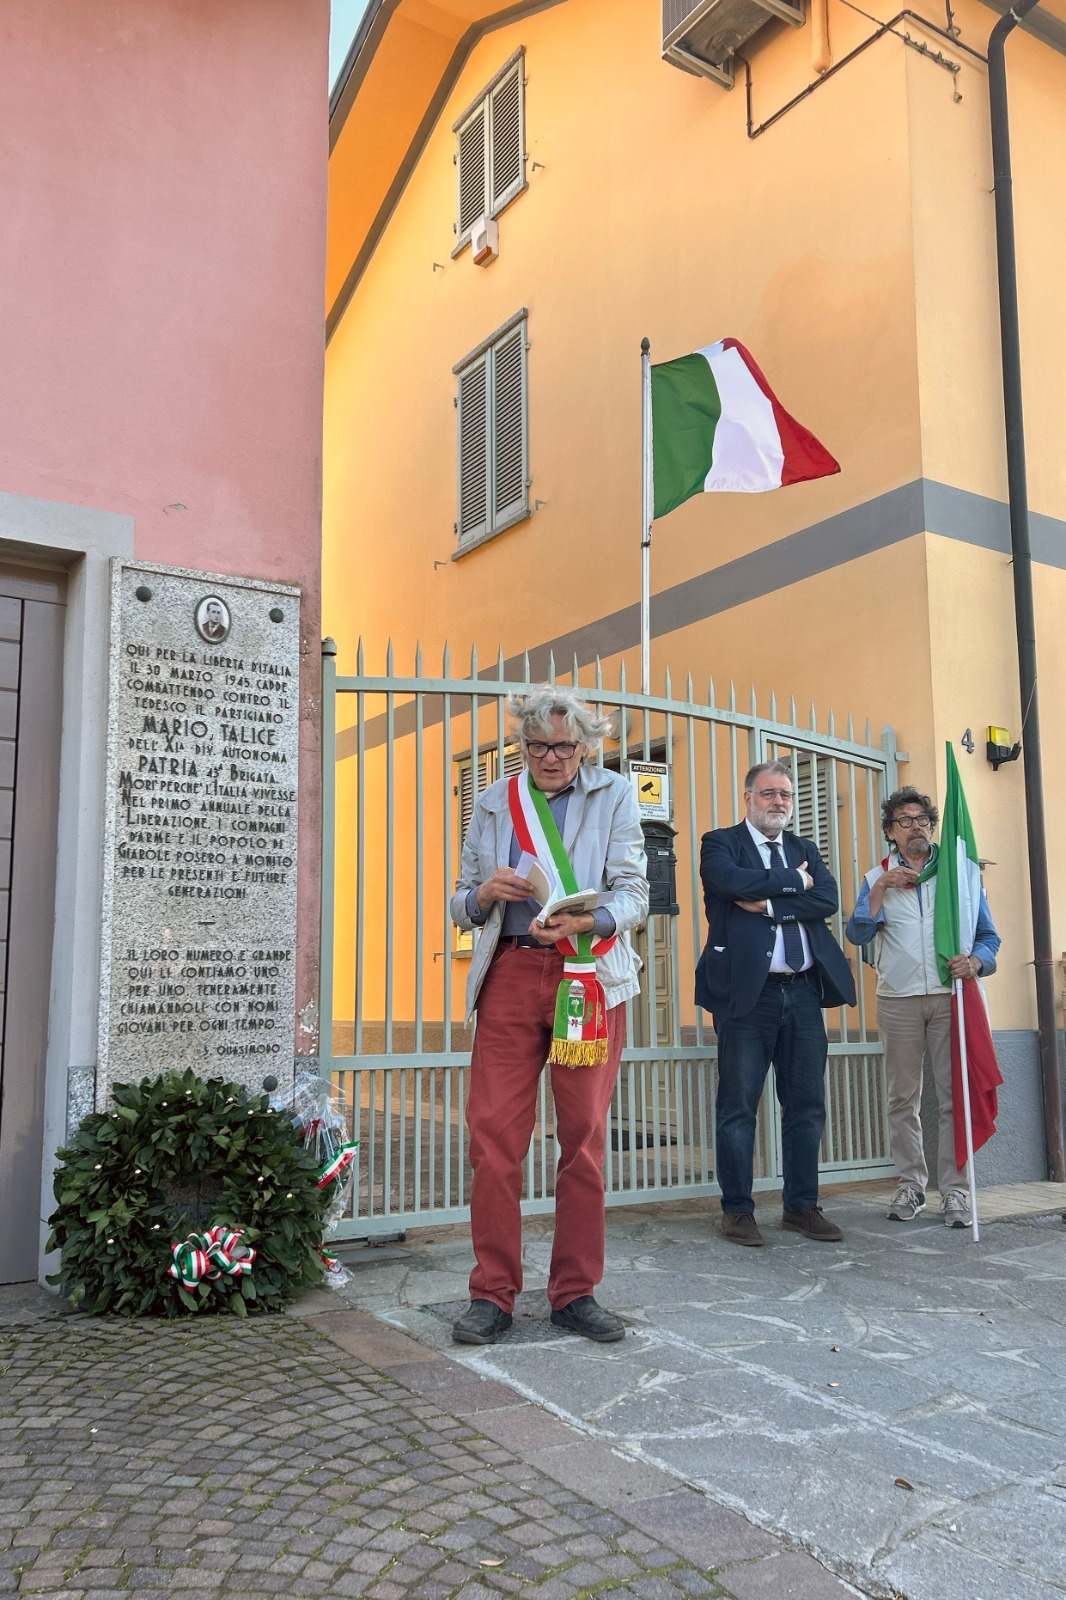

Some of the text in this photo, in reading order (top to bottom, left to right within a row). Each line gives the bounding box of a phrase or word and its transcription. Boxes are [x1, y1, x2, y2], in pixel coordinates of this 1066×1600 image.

[127, 644, 149, 657] QUI
[157, 648, 176, 661] PER
[183, 653, 196, 663] LA
[251, 661, 291, 677] D'ITALIA
[131, 662, 288, 693] IL 30 MARZO 1945 CADDE
[127, 679, 291, 709] COMBATTENDO CONTRO IL
[135, 697, 283, 724] TEDESCO IL PARTIGIANO
[221, 724, 276, 746] TALICE
[961, 728, 974, 754] 4
[222, 746, 287, 764] AUTONOMA
[139, 755, 198, 777] PATRIA
[253, 788, 296, 801] VIVESSE
[151, 798, 191, 810] PRIMO
[200, 801, 251, 815] ANNUALE
[258, 805, 291, 817] DELLA
[231, 820, 286, 833] COMPAGNI
[179, 834, 184, 844] E
[192, 834, 202, 845] IL
[210, 835, 267, 849] POPOLO
[176, 851, 226, 865] POSERO
[232, 854, 238, 864] A
[245, 855, 293, 867] MONITO
[123, 866, 287, 884] PER LE PRESENTI E FUTURE
[168, 886, 246, 899] GENERAZIONI
[143, 950, 179, 961] LORO
[186, 950, 233, 961] NUMERO
[253, 950, 291, 961] GRANDE
[128, 966, 279, 980] QUI LI CONTIAMO UNO
[129, 985, 150, 999] PER
[198, 984, 277, 996] TENERAMENTE
[121, 1001, 278, 1016] CHIAMANDOLI CON NOMI
[118, 1022, 167, 1034] GIOVANI
[172, 1020, 194, 1031] PER
[200, 1020, 228, 1031] OGNI
[217, 1044, 280, 1055] QUASIMODO
